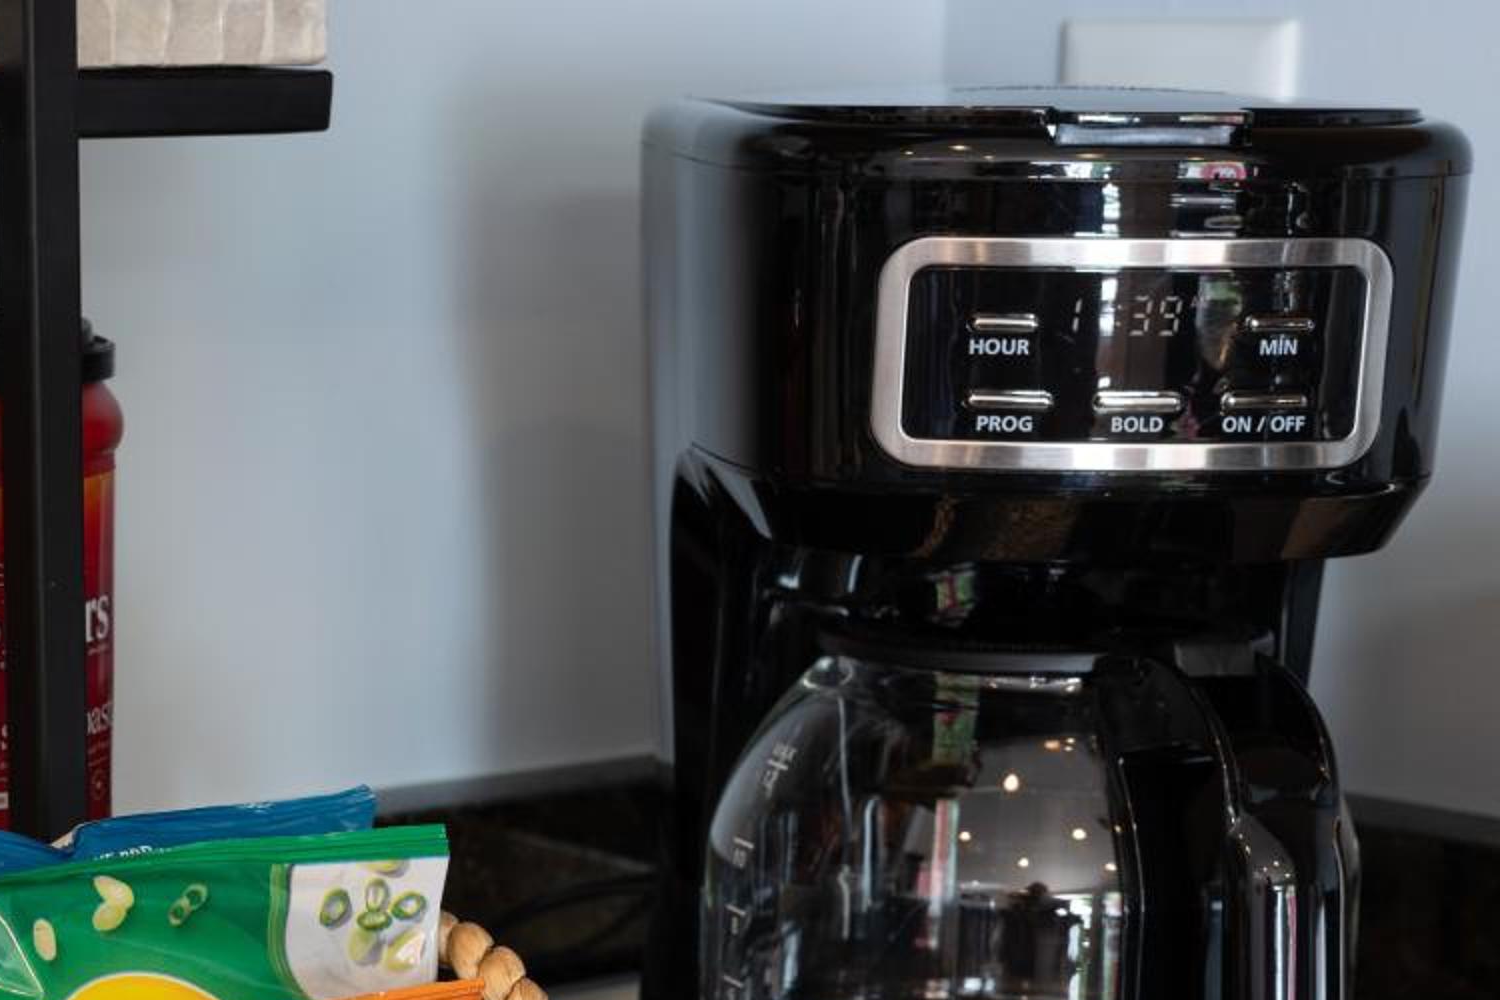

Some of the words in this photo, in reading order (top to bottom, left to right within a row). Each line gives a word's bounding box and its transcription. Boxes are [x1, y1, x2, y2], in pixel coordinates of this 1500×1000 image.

[969, 338, 1030, 356] HOUR
[1258, 338, 1299, 356] MIN
[976, 415, 1034, 433] PROG
[1111, 415, 1164, 433] BOLD
[1222, 416, 1251, 433] ON
[1270, 415, 1306, 433] OFF
